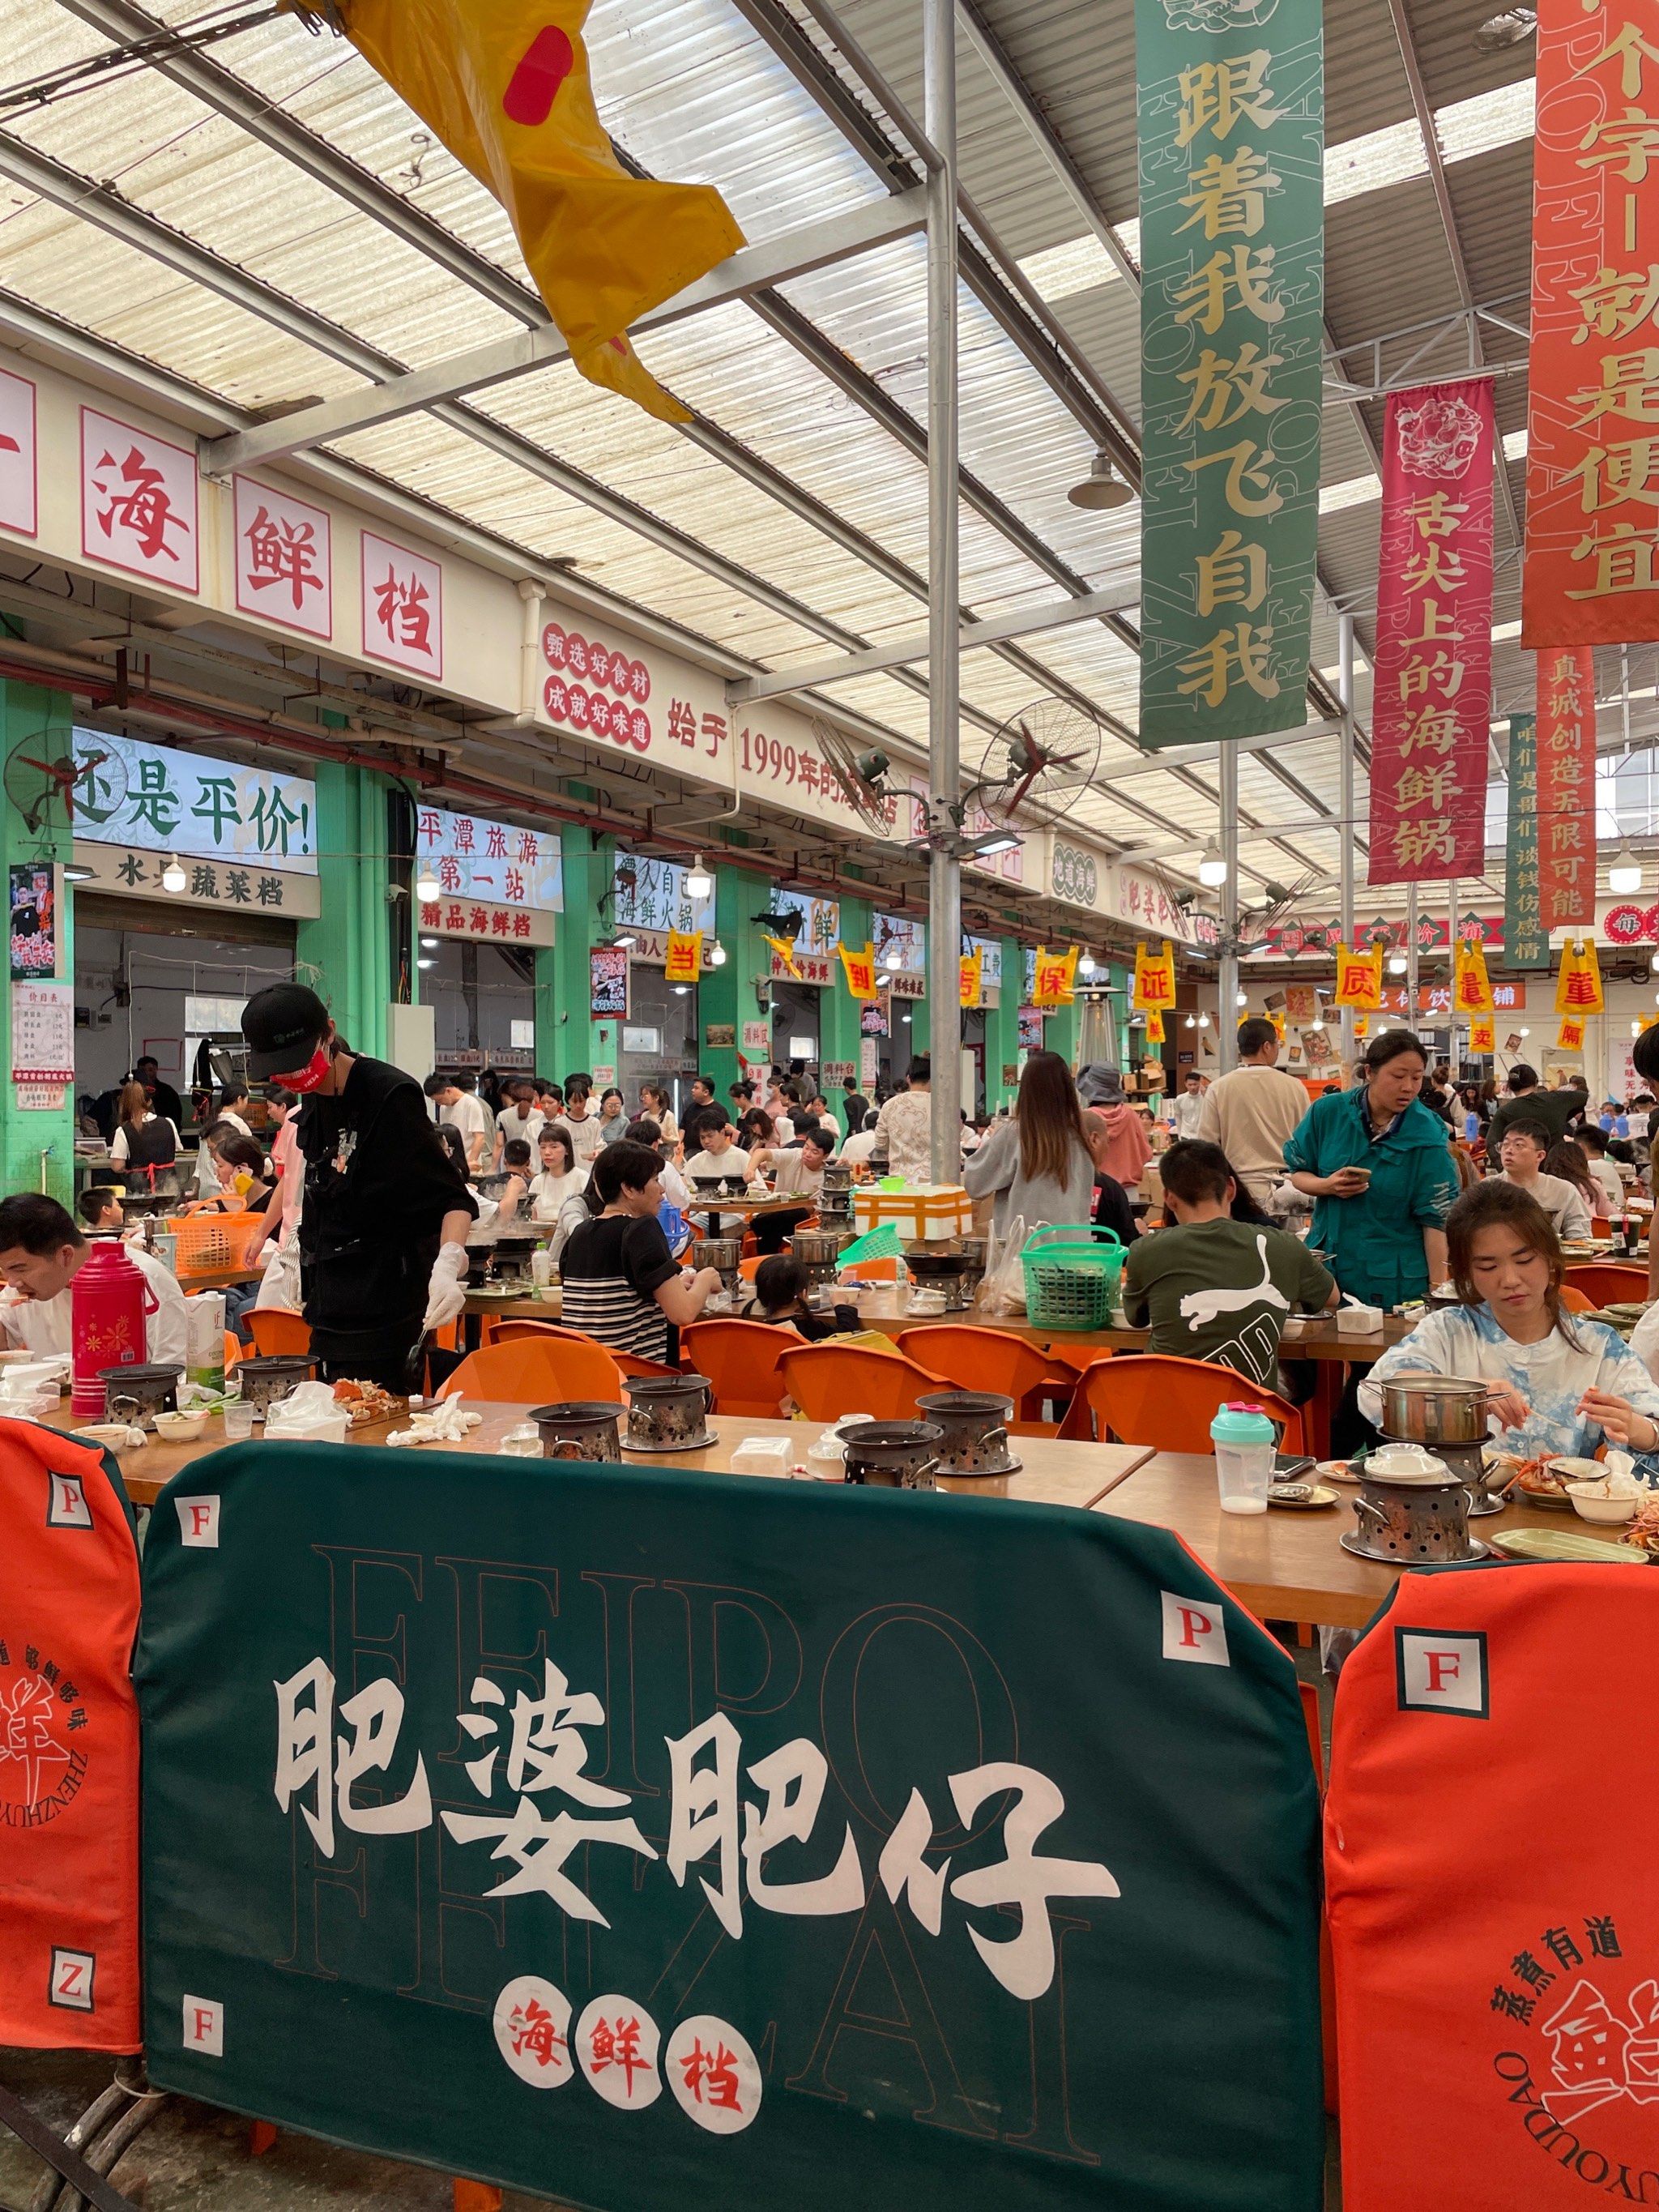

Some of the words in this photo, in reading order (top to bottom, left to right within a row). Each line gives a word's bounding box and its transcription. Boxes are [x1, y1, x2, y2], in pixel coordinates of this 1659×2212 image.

[1171, 49, 1292, 707] 跟着我放飞自我
[0, 435, 433, 657] 海鲜档
[547, 632, 648, 696] 甄选好食材
[1390, 490, 1469, 869] 舌尖上的海鲜锅
[548, 684, 648, 743] 成就好味道
[1548, 655, 1586, 918] 真诚创造无限可能
[418, 811, 539, 866] 平潭旅游
[437, 855, 525, 902] 第一站
[420, 903, 531, 937] 精品海鲜档
[672, 944, 694, 971] 当
[848, 963, 870, 990] 到
[1039, 967, 1067, 996] 保
[1141, 970, 1171, 1000] 证
[1341, 965, 1375, 998] 质
[1460, 971, 1486, 1005] 量
[1563, 971, 1598, 1005] 童
[1473, 1028, 1491, 1046] 卖
[1562, 1024, 1582, 1045] 隔
[62, 1484, 79, 1514] P
[189, 1505, 211, 1536] F
[1177, 1607, 1212, 1648] P
[1424, 1650, 1461, 1693] F
[273, 1656, 1121, 2000] 肥婆肥仔
[58, 1962, 84, 1996] Z
[1490, 1915, 1623, 2026] 蒸煮有道
[194, 2007, 214, 2041] F
[510, 1997, 744, 2114] 海鲜档
